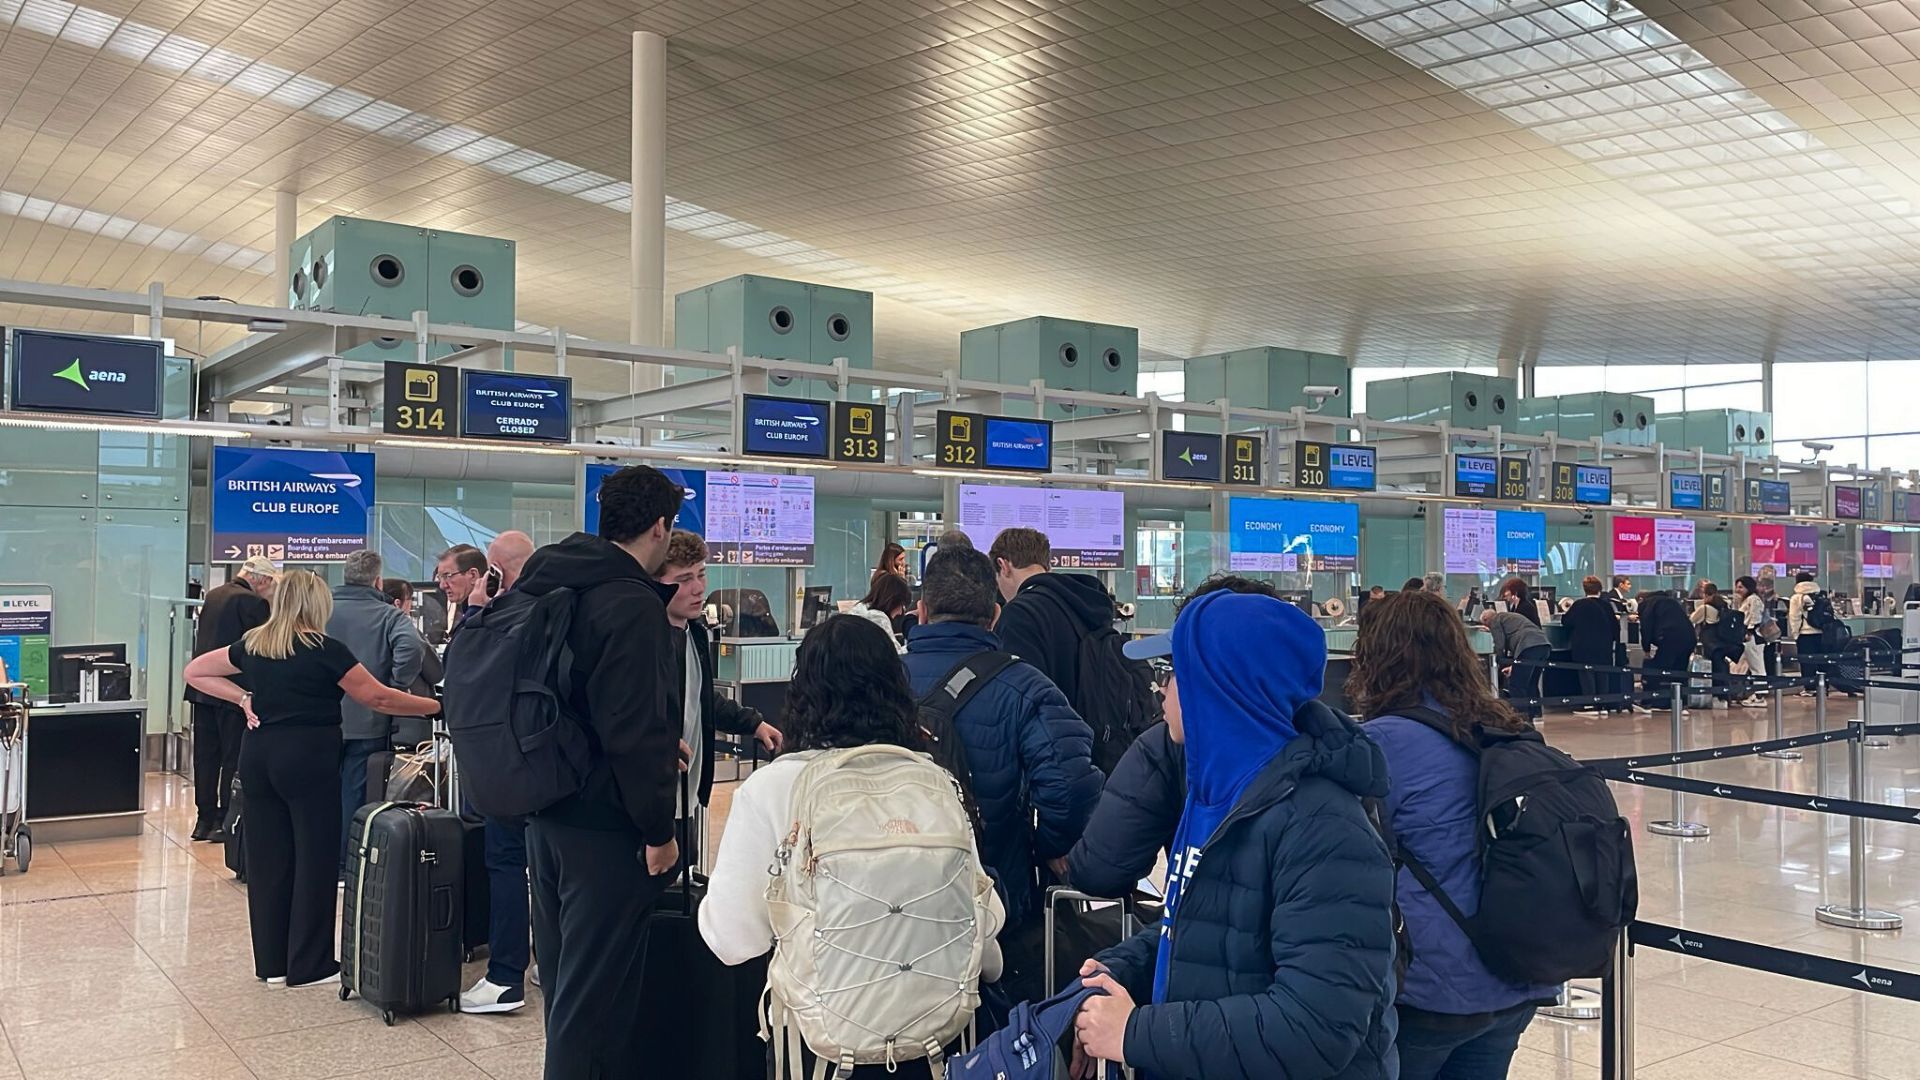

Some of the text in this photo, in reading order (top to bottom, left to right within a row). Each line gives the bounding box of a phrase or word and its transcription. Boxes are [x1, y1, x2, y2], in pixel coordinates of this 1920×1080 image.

[89, 370, 126, 382] aena
[475, 389, 543, 400] BRITISH AIRWAYS
[396, 405, 445, 431] 314
[496, 416, 539, 427] CERRADO
[754, 418, 808, 429] BRITISH AIRWAYS
[499, 425, 535, 434] CLOSED
[765, 431, 809, 442] CLUB EUROPE
[843, 438, 878, 458] 313
[992, 441, 1012, 449] BRITISH
[944, 444, 976, 464] 312
[1342, 453, 1373, 468] LEVEL
[1468, 460, 1495, 471] LEVEL
[1233, 464, 1256, 481] 311
[1301, 469, 1323, 485] 310
[1585, 472, 1609, 485] LEVEL
[228, 479, 337, 494] BRITISH AIRWAYS
[1504, 482, 1525, 497] 309
[1681, 479, 1701, 491] LEVEL
[1554, 486, 1574, 500] 308
[252, 502, 340, 514] CLUB EUROPE
[1245, 521, 1282, 531] ECONOMY
[1310, 524, 1345, 533] ECONOMY
[287, 536, 363, 545] Portes d'embarcament
[1684, 938, 1703, 949] aena
[1870, 976, 1893, 987] aena
